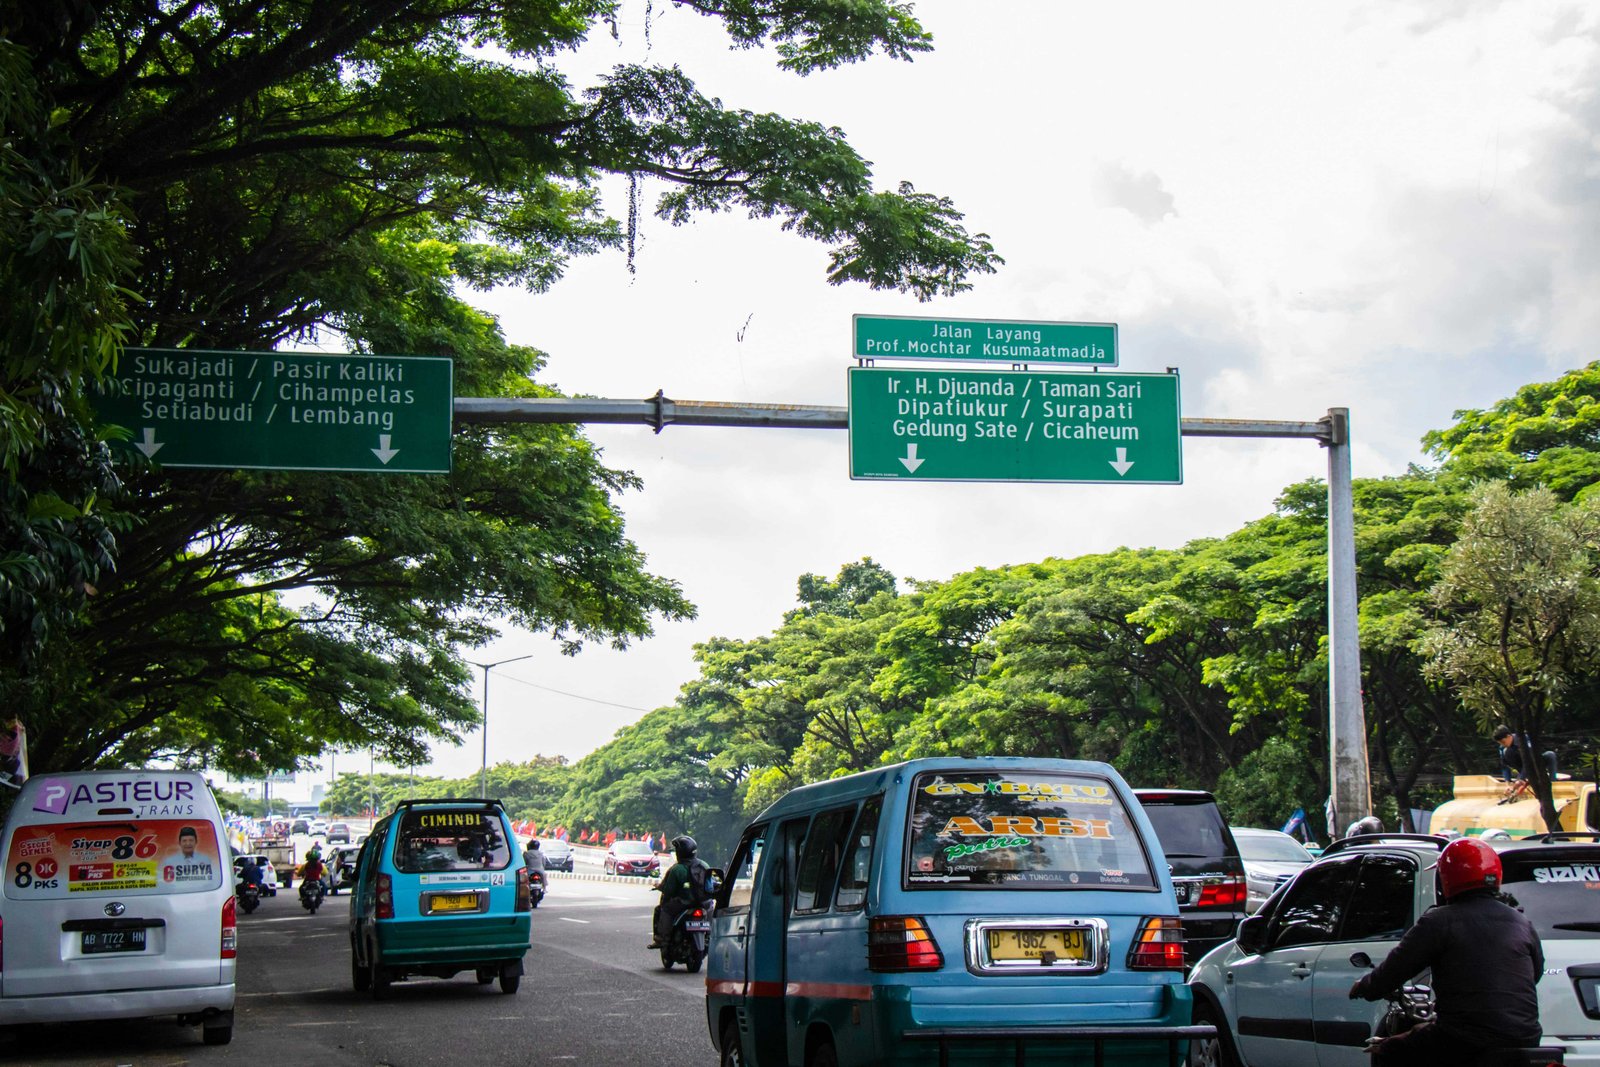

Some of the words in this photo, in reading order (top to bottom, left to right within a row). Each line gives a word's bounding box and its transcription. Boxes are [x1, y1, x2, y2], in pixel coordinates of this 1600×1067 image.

[932, 324, 972, 338] Jalan
[987, 327, 1041, 344] Layang
[983, 343, 1105, 359] Kusumaatmadja
[134, 356, 233, 380] Sukajadi
[273, 361, 331, 379] Pasir
[339, 362, 403, 382] Kaliki
[121, 378, 234, 402] Cipaganti
[279, 382, 415, 406] Cihampelas
[915, 377, 932, 394] H.
[938, 377, 1014, 400] Djuanda
[1039, 380, 1101, 398] Taman
[1106, 381, 1141, 399] Sari
[141, 401, 252, 422] Setiabudi
[291, 406, 394, 431] Lembang
[898, 398, 1008, 420] Dipatiukur
[1043, 401, 1133, 422] Surapati
[893, 419, 967, 442] Gedung
[974, 421, 1018, 438] Sate
[1043, 422, 1139, 440] Cicaheum
[999, 782, 1110, 797] BATU
[139, 805, 193, 816] TRANS
[936, 816, 1114, 840] ARBI
[72, 838, 112, 850] Siyap
[15, 862, 32, 889] 8
[116, 867, 125, 878] 6
[163, 865, 175, 883] 6
[175, 863, 213, 876] SURYA
[1533, 866, 1600, 883] SUZUKI
[34, 880, 58, 890] PKS
[492, 875, 504, 886] 24
[84, 934, 96, 944] AB
[102, 933, 124, 944] 7722
[992, 932, 1000, 949] D
[1016, 931, 1047, 949] 1962
[1063, 932, 1081, 949] BJ
